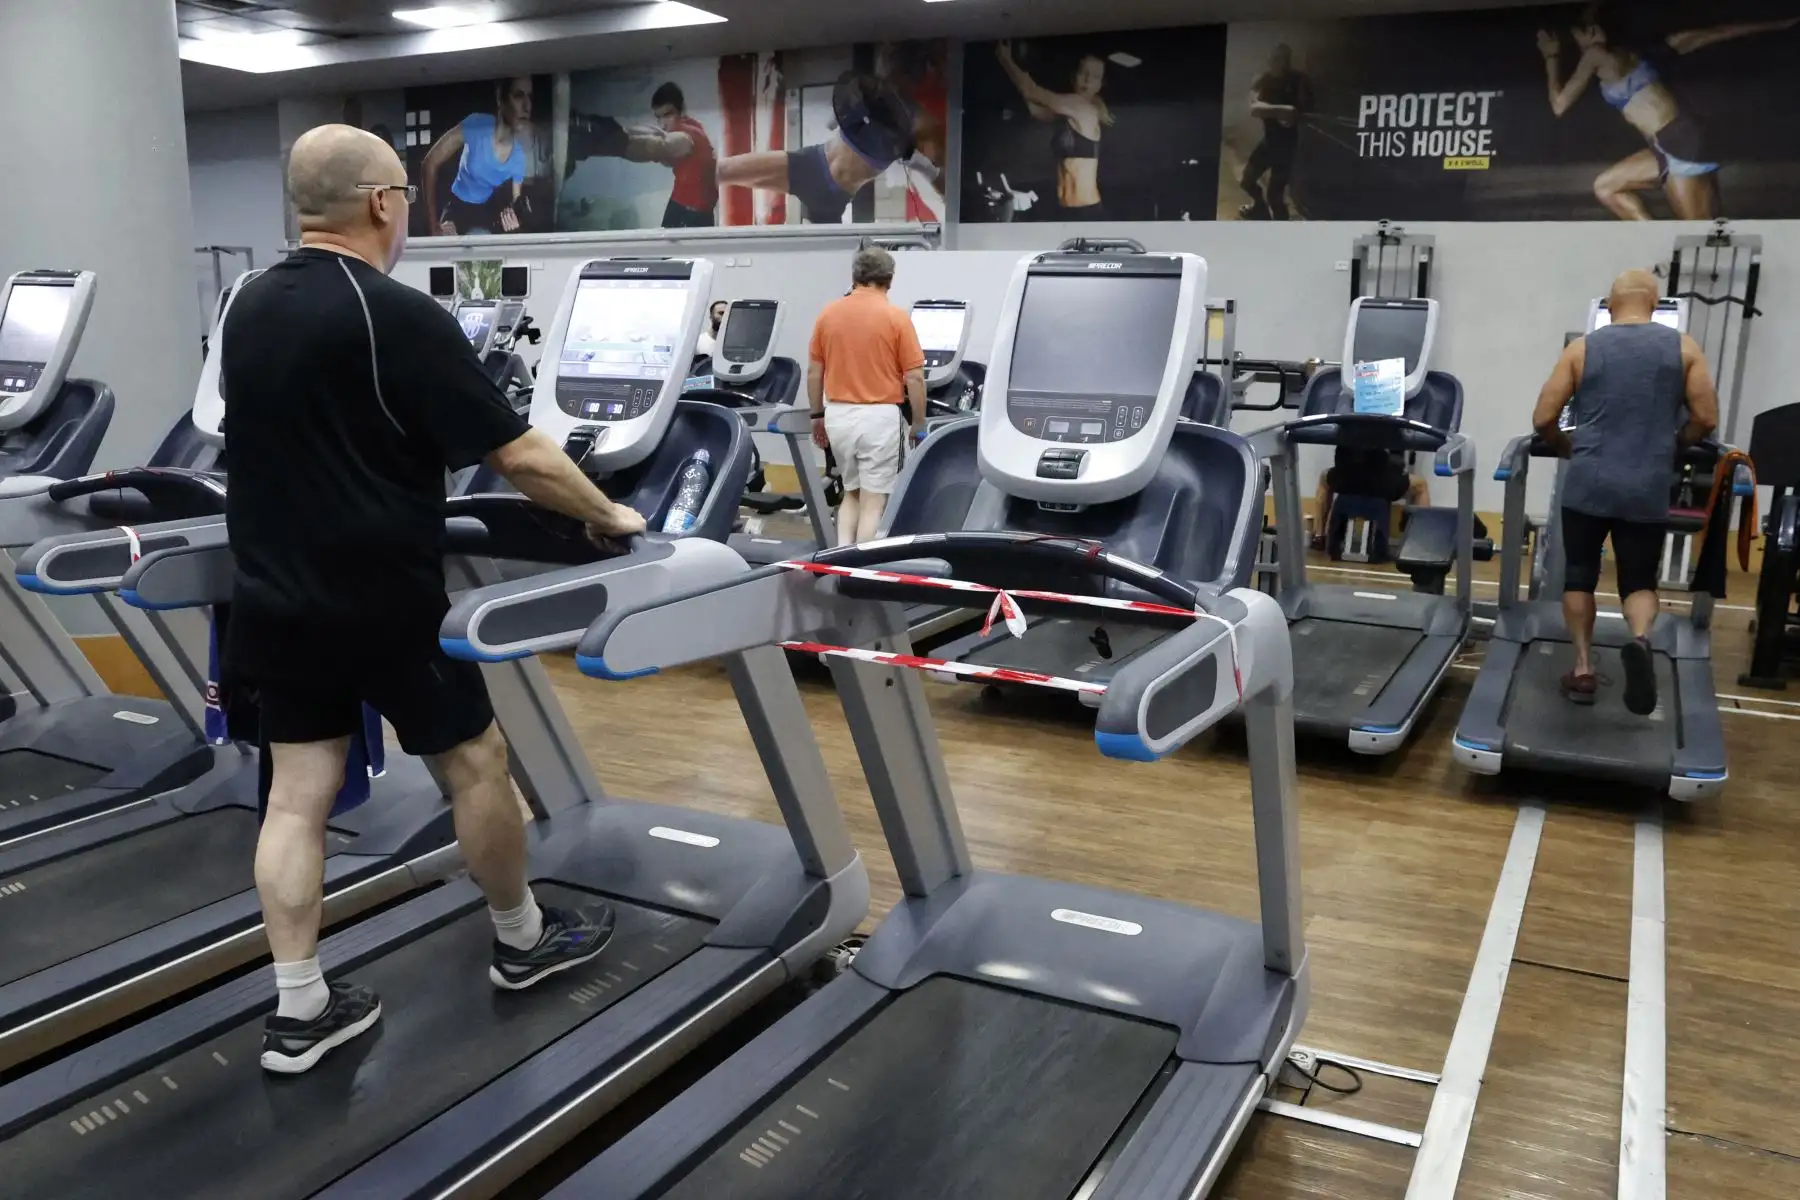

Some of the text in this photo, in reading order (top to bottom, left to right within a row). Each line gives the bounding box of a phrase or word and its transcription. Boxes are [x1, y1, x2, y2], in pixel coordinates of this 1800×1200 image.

[1358, 91, 1496, 128] PROTECT
[1356, 129, 1497, 157] THIS HOUSE.
